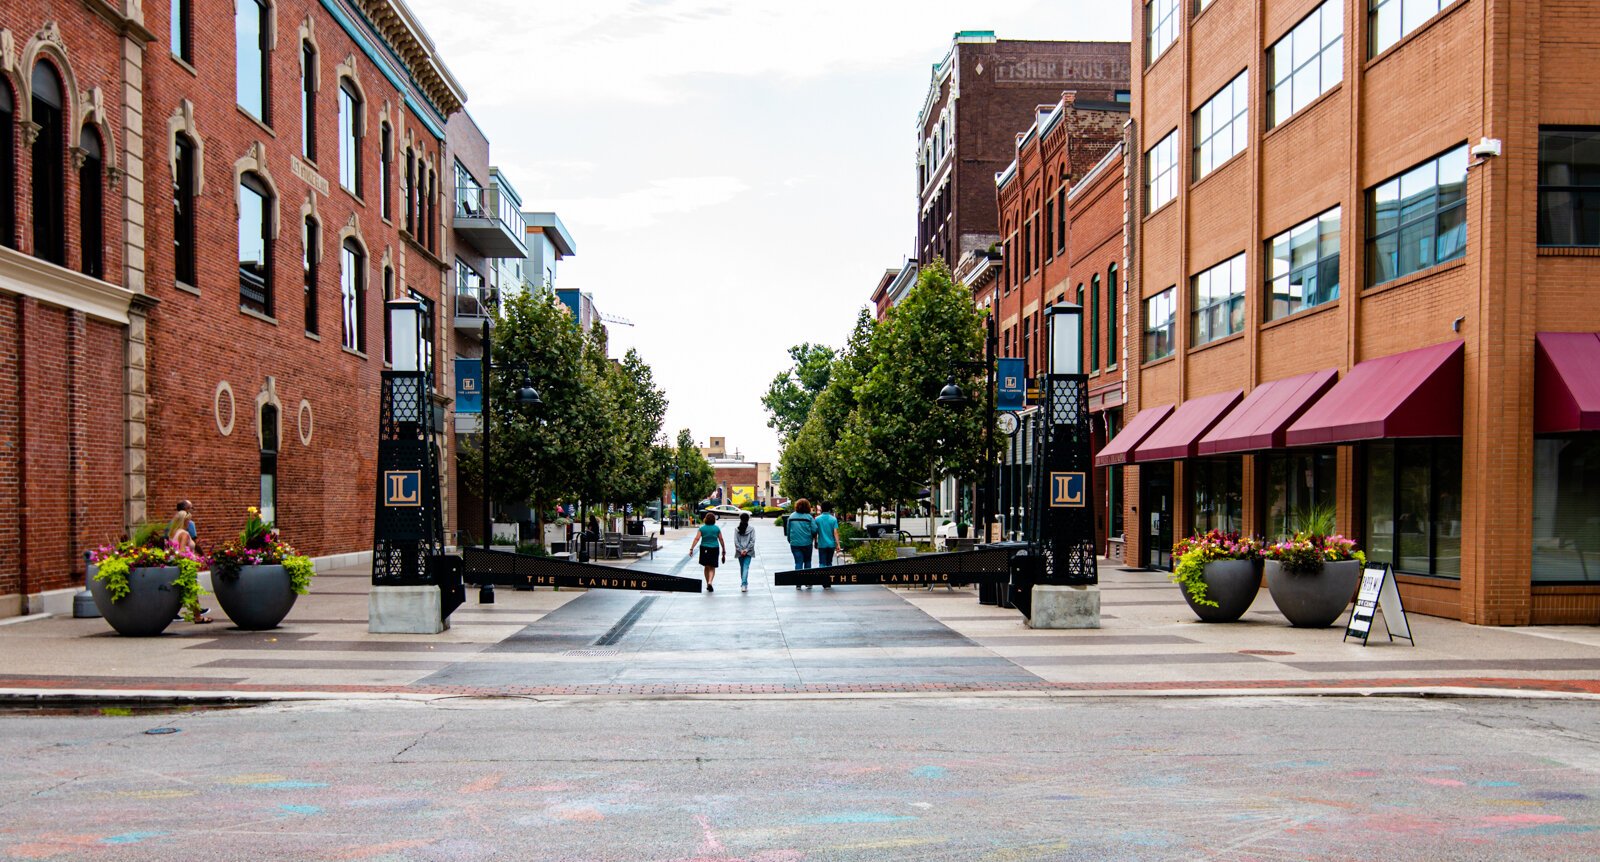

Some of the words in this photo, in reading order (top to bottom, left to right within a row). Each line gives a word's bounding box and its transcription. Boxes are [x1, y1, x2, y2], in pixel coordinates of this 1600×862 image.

[998, 59, 1057, 79] FISHER
[527, 575, 555, 584] THE
[579, 578, 648, 588] LANDING
[880, 573, 949, 582] LANDING
